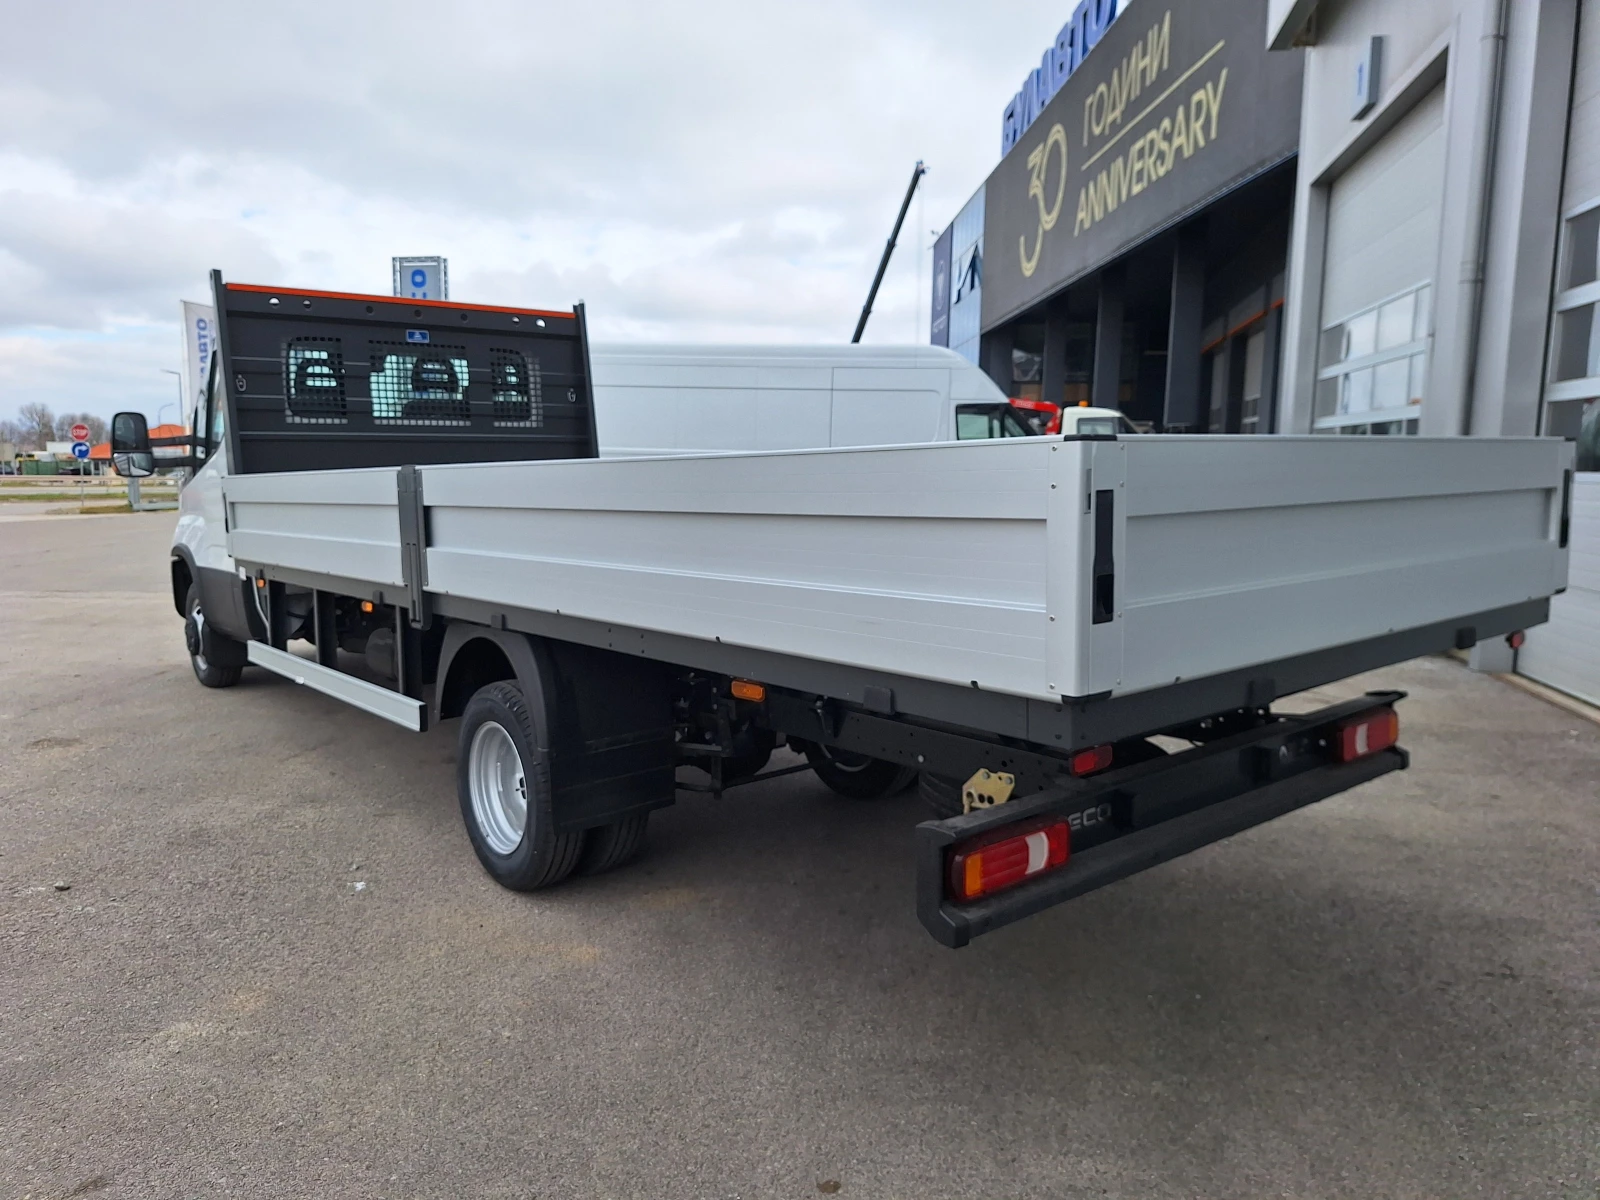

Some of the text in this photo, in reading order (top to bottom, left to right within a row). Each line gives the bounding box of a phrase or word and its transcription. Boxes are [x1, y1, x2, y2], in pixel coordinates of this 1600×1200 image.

[1002, 0, 1117, 158] БУЛАВТО
[1073, 67, 1229, 237] ANNIVERSARY
[1082, 9, 1172, 147] ГОДИНИ
[1019, 122, 1068, 277] 30
